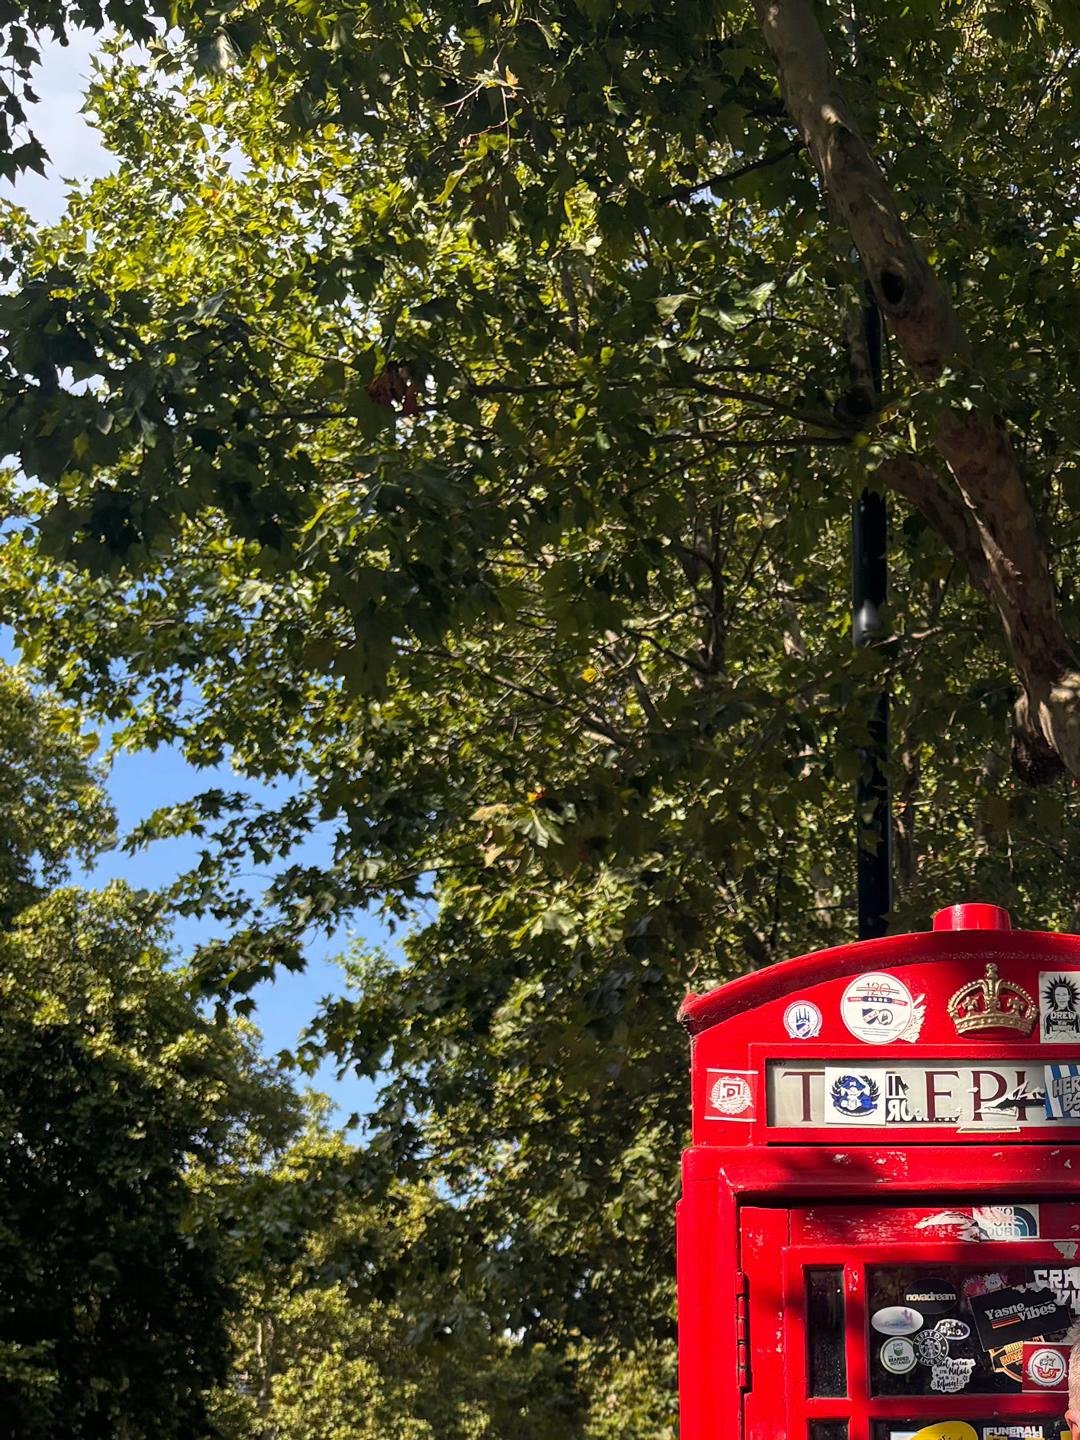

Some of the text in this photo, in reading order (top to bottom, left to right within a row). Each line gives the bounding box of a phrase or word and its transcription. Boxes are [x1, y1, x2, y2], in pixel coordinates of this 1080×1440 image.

[1050, 1010, 1077, 1020] DREW
[905, 1291, 957, 1302] novadream
[984, 1302, 1025, 1321] Yasne
